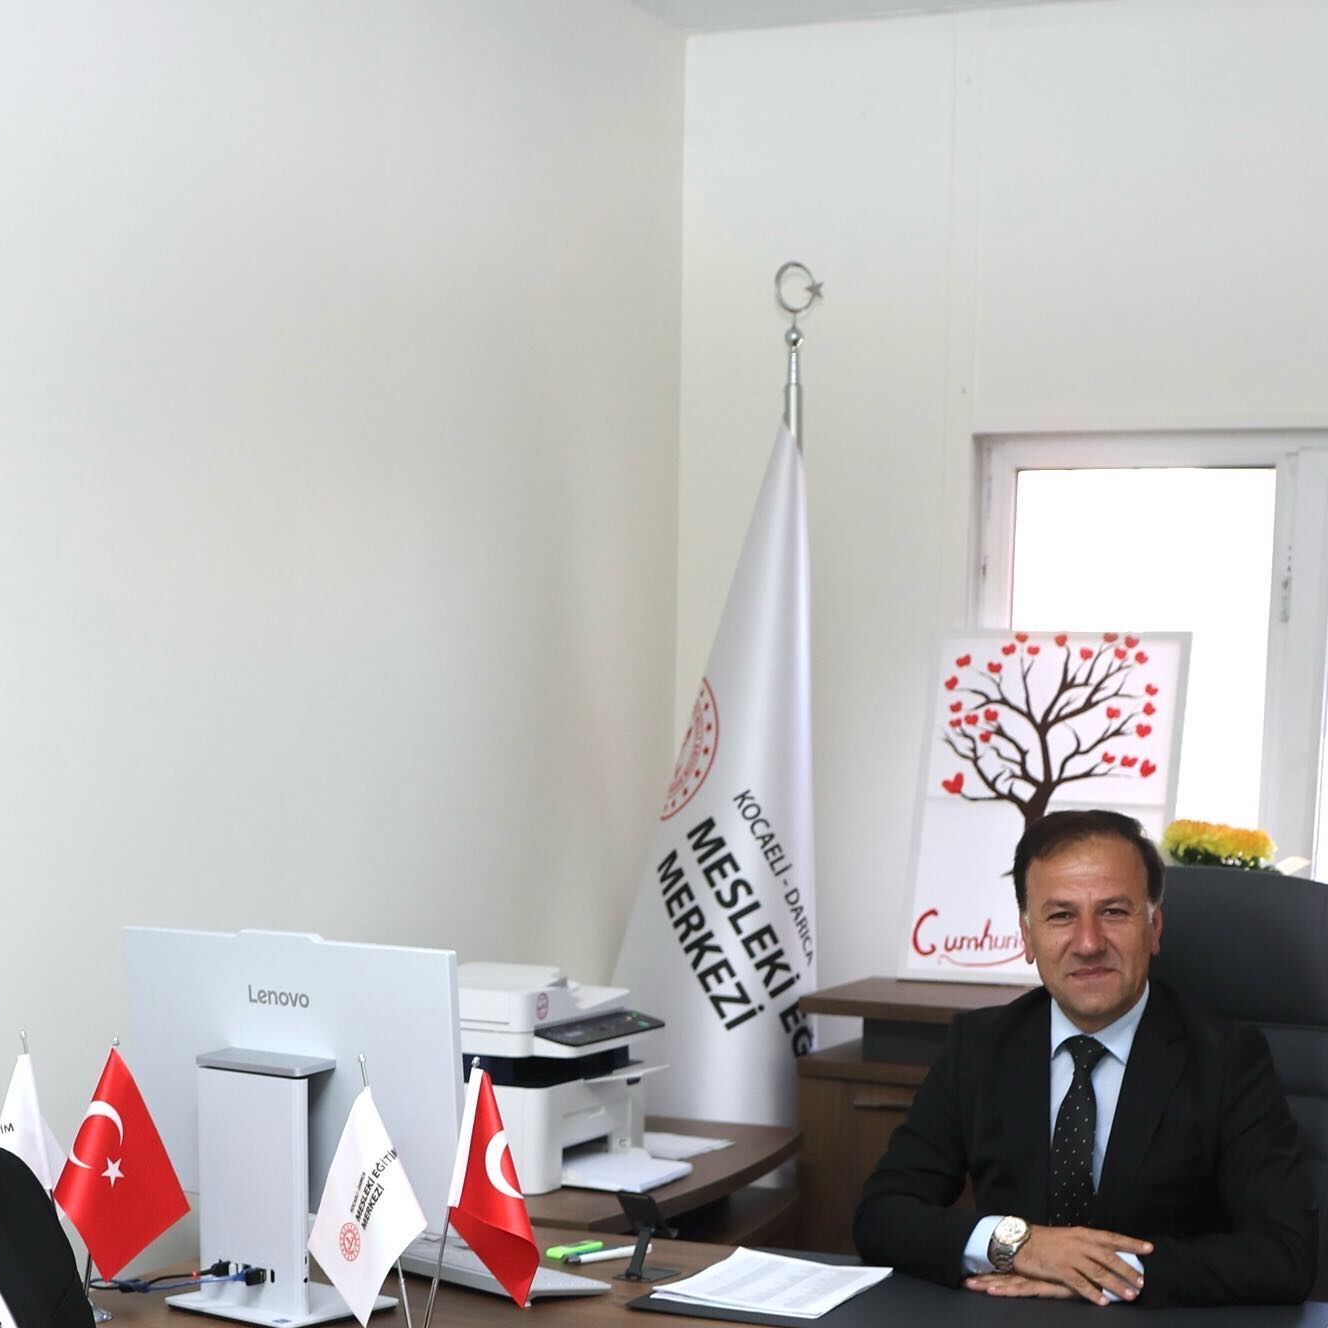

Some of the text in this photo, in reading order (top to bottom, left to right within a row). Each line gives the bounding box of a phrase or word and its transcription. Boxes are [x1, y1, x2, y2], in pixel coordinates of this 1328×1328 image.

[733, 789, 793, 877] KOCAELİ
[687, 816, 800, 998] MESLEKİ
[658, 849, 765, 1031] MERKEZİ
[912, 908, 1028, 967] Cumhuri
[248, 984, 310, 1008] Lenovo
[355, 1176, 376, 1222] MESLEKİ
[361, 1183, 385, 1231] MERKEZİ
